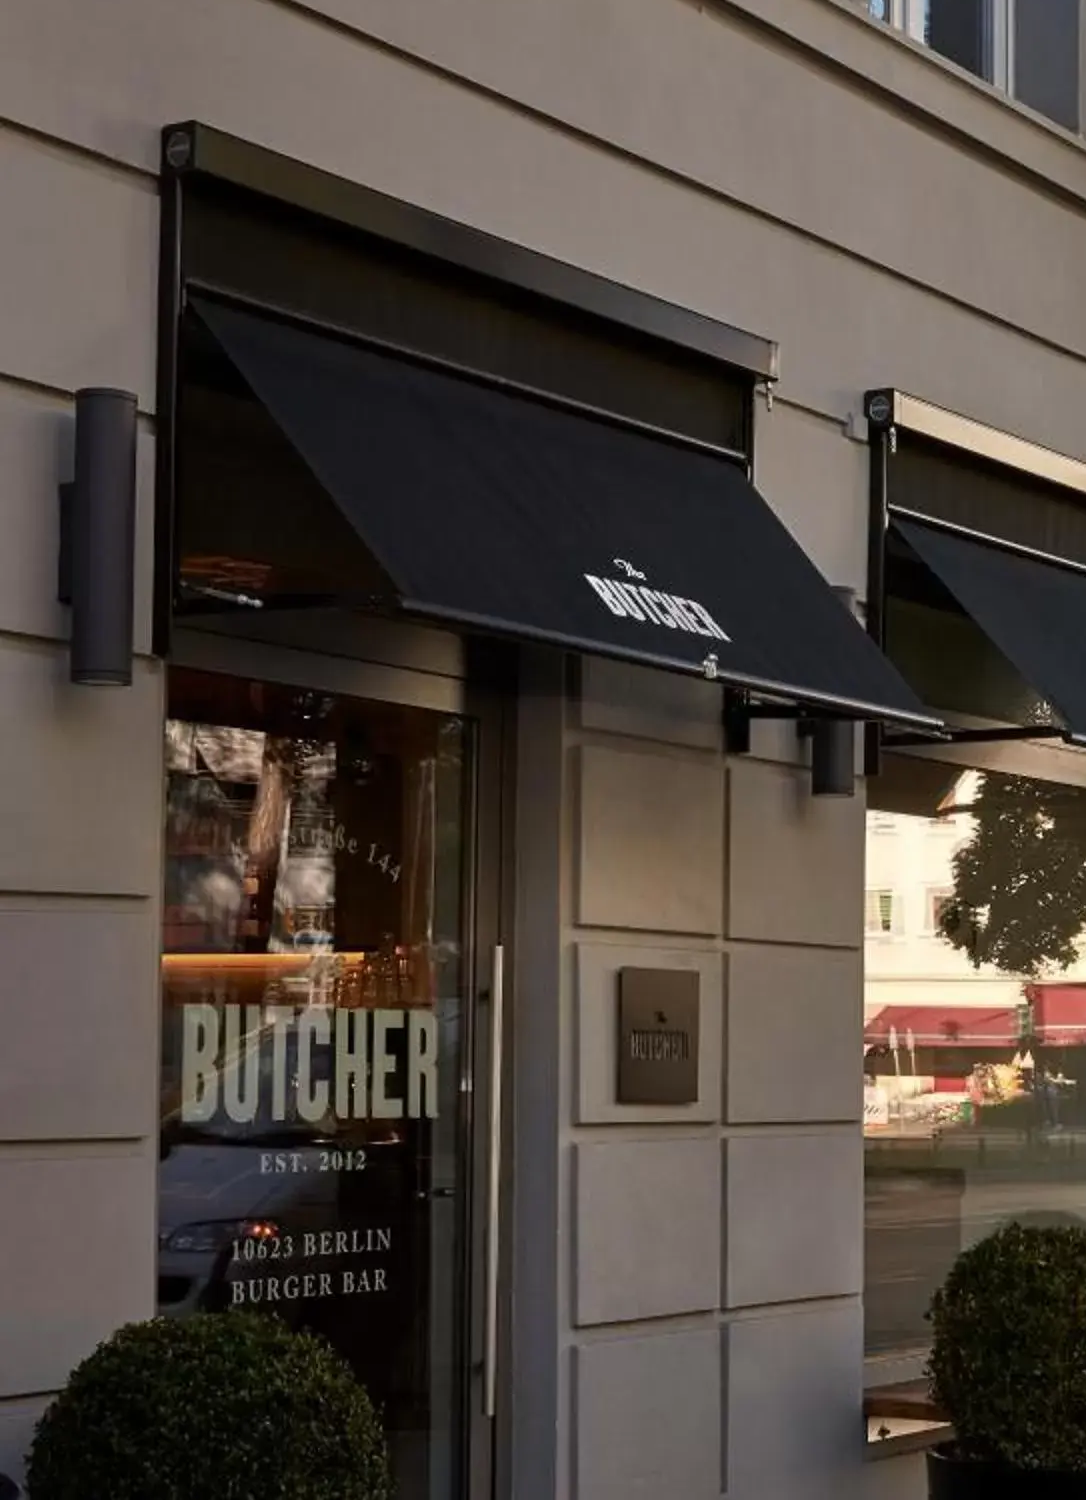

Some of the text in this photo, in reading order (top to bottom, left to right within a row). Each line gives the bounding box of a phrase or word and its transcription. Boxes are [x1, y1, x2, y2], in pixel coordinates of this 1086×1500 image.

[583, 572, 733, 643] BUTCHER
[366, 842, 401, 883] 144
[180, 1003, 439, 1124] BUTCHER
[260, 1149, 367, 1174] EST. 2012
[231, 1227, 392, 1262] 10623 BERLIN
[231, 1267, 388, 1305] BURGER BAR
